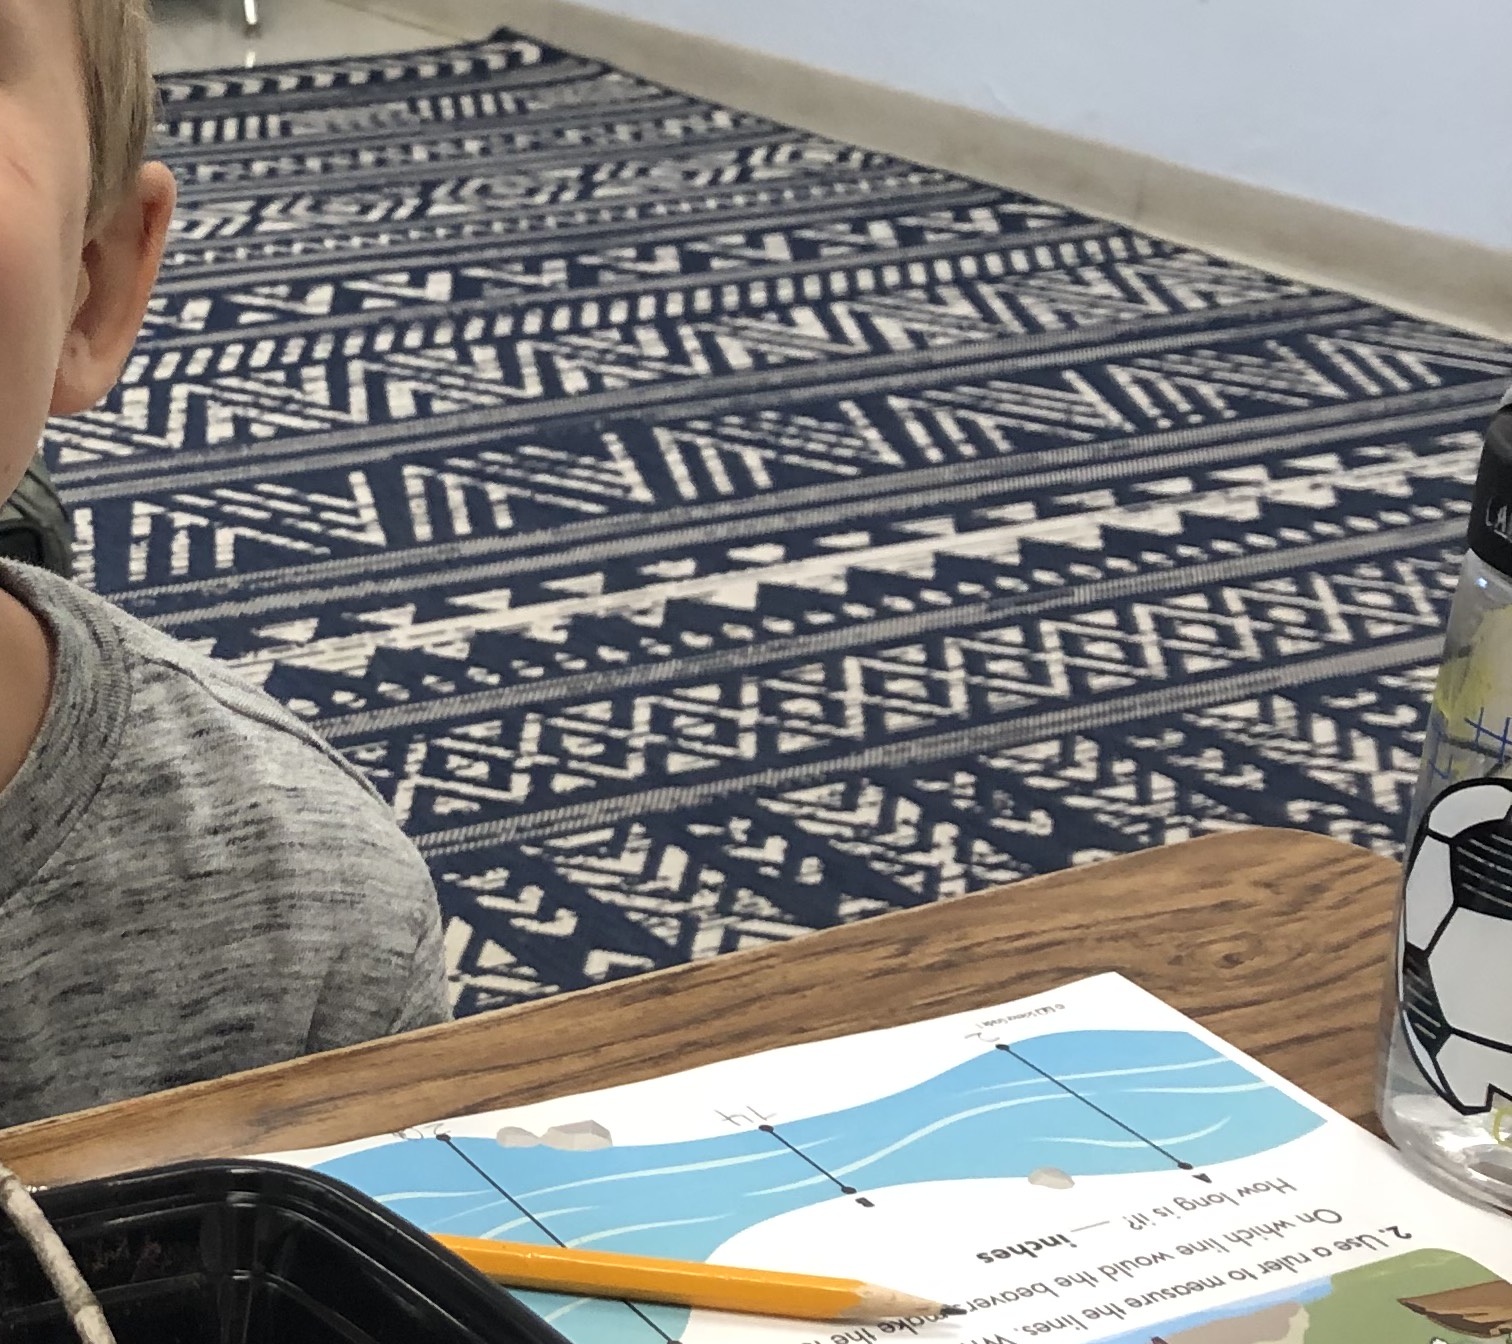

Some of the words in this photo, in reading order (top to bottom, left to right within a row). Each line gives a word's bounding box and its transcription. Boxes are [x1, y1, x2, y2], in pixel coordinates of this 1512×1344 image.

[1237, 1177, 1298, 1198] How
[1173, 1191, 1240, 1212] long
[1122, 1212, 1157, 1231] it?
[1152, 1206, 1182, 1220] is
[1295, 1208, 1343, 1224] On
[1223, 1218, 1297, 1247] which
[1378, 1225, 1412, 1240] 2.
[976, 1233, 1078, 1264] inches
[1175, 1237, 1231, 1255] line
[1312, 1246, 1333, 1258] a
[1333, 1234, 1389, 1252] Use
[1096, 1249, 1176, 1283] would
[1258, 1252, 1313, 1274] ruler
[1053, 1269, 1100, 1288] the
[1228, 1269, 1259, 1282] to
[1124, 1276, 1228, 1309] measure
[1081, 1301, 1128, 1322] the
[1014, 1313, 1088, 1337] lines.
